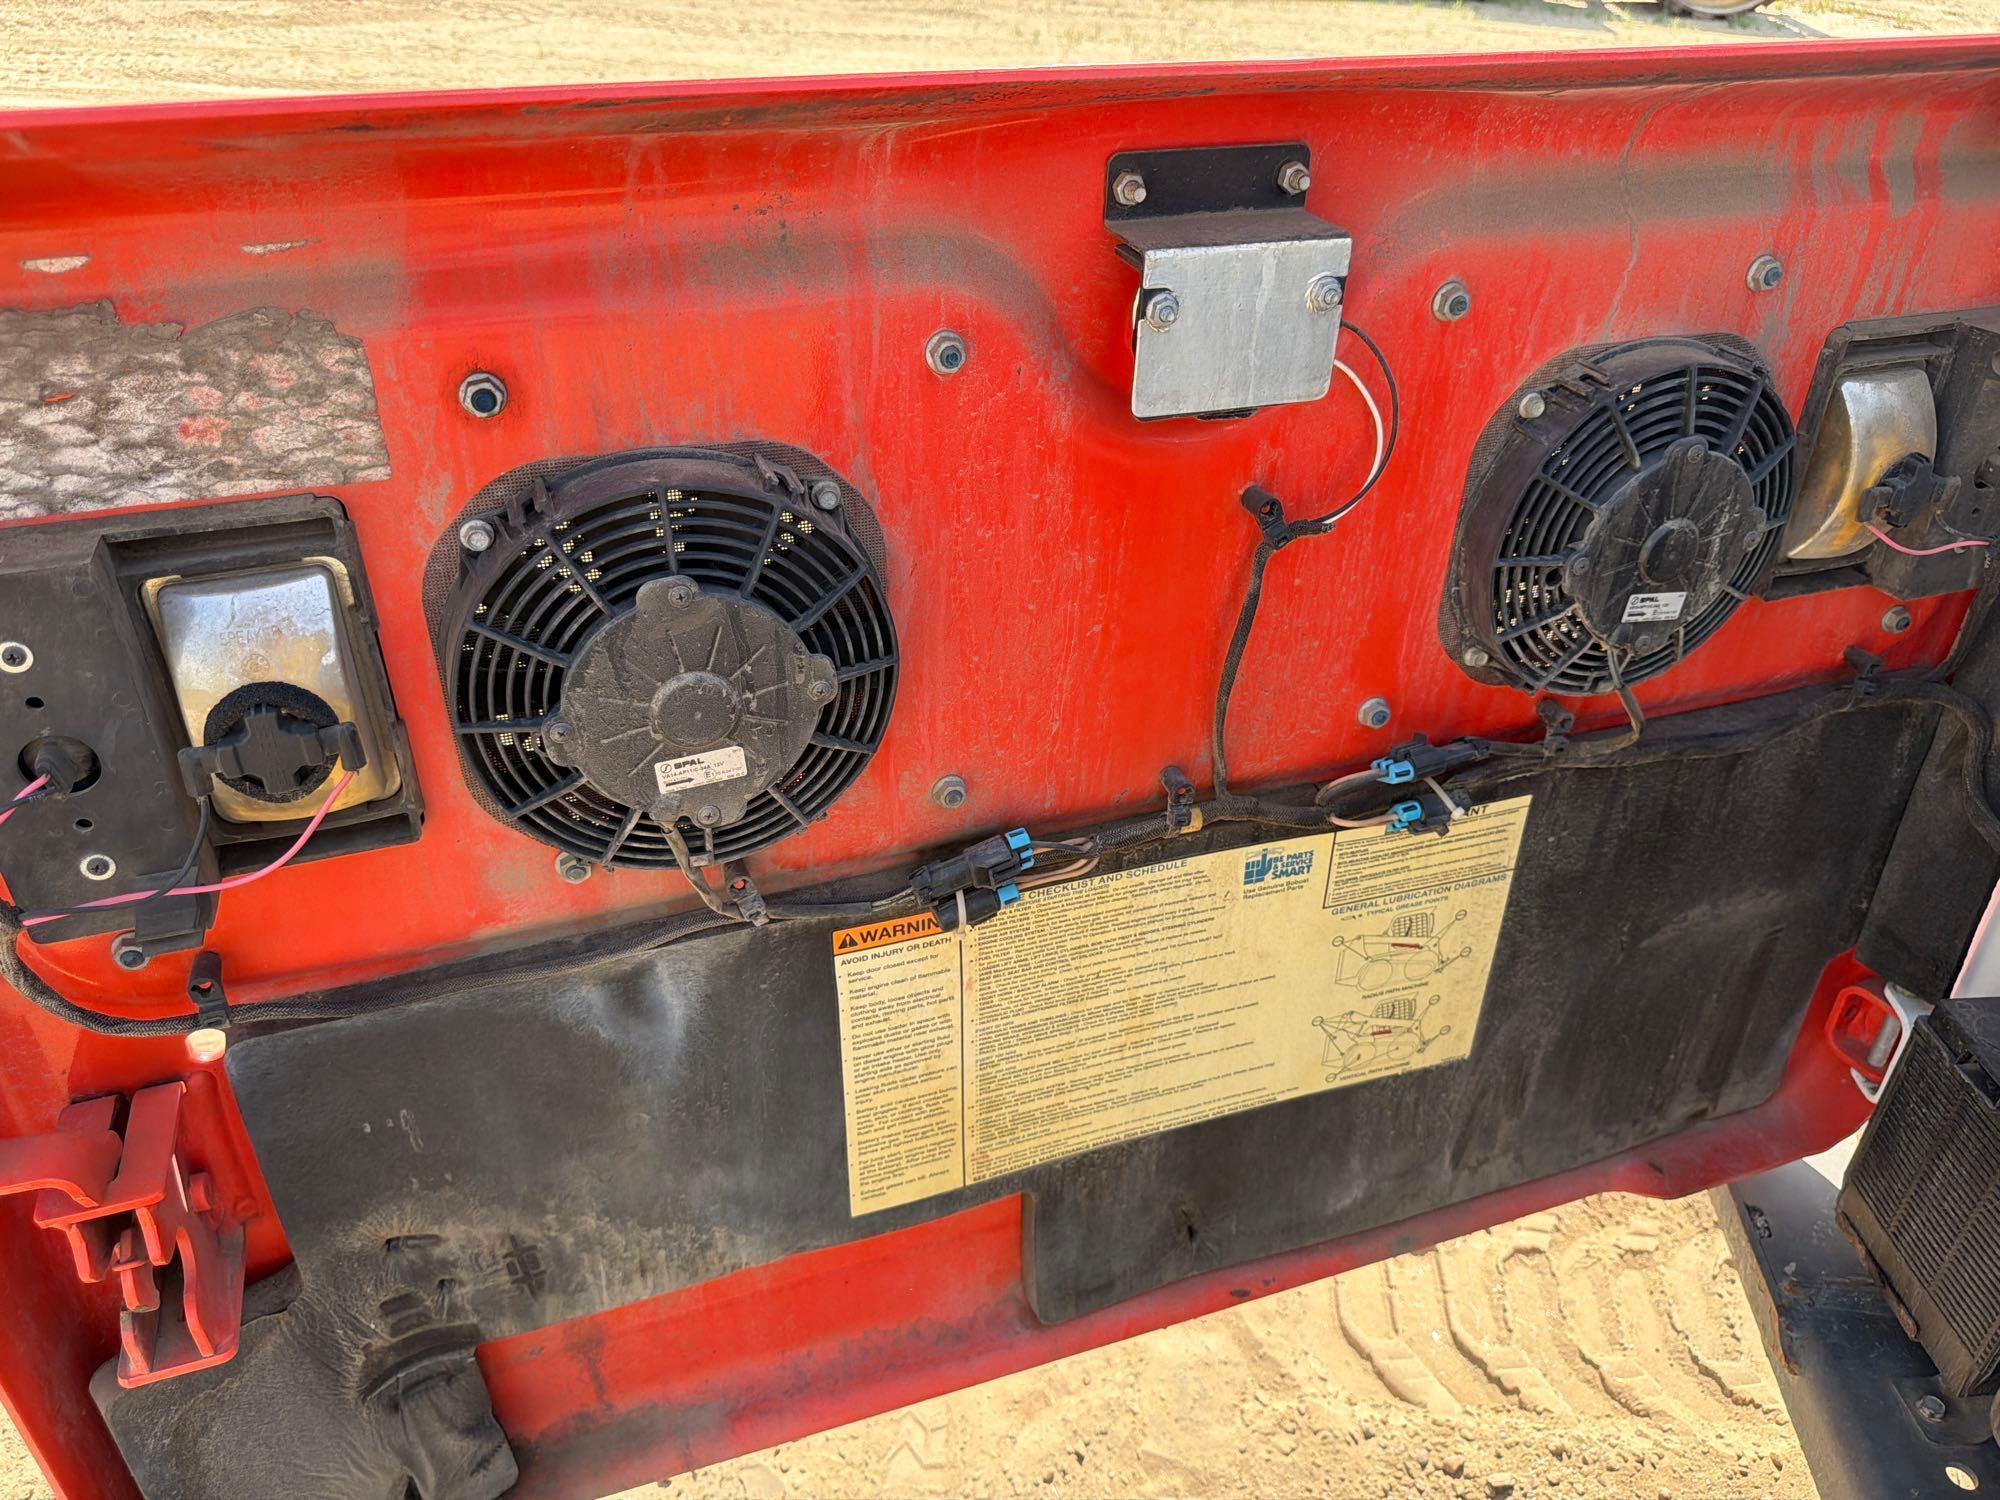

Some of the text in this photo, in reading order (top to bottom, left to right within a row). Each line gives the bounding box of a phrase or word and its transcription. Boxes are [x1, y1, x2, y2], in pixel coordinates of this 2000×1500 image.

[673, 757, 705, 770] SPAL
[1280, 856, 1312, 869] SERVICE
[1286, 849, 1314, 860] PARTS
[1028, 878, 1095, 899] CHECKLIST
[1098, 873, 1122, 884] AND
[1126, 859, 1187, 878] SCHEDULE
[1271, 863, 1312, 880] SMART
[1242, 882, 1304, 899] Replacement Parts
[1257, 883, 1284, 891] Genuine
[1285, 877, 1308, 886] Bobcat
[1331, 873, 1507, 915] GENERAL LUBRICATION DIAGRAMS
[1366, 907, 1393, 916] TYPICAL
[1395, 900, 1423, 910] GREASE
[860, 918, 941, 943] WARNIN
[840, 936, 951, 965] AVOID INJURY OR DEATH
